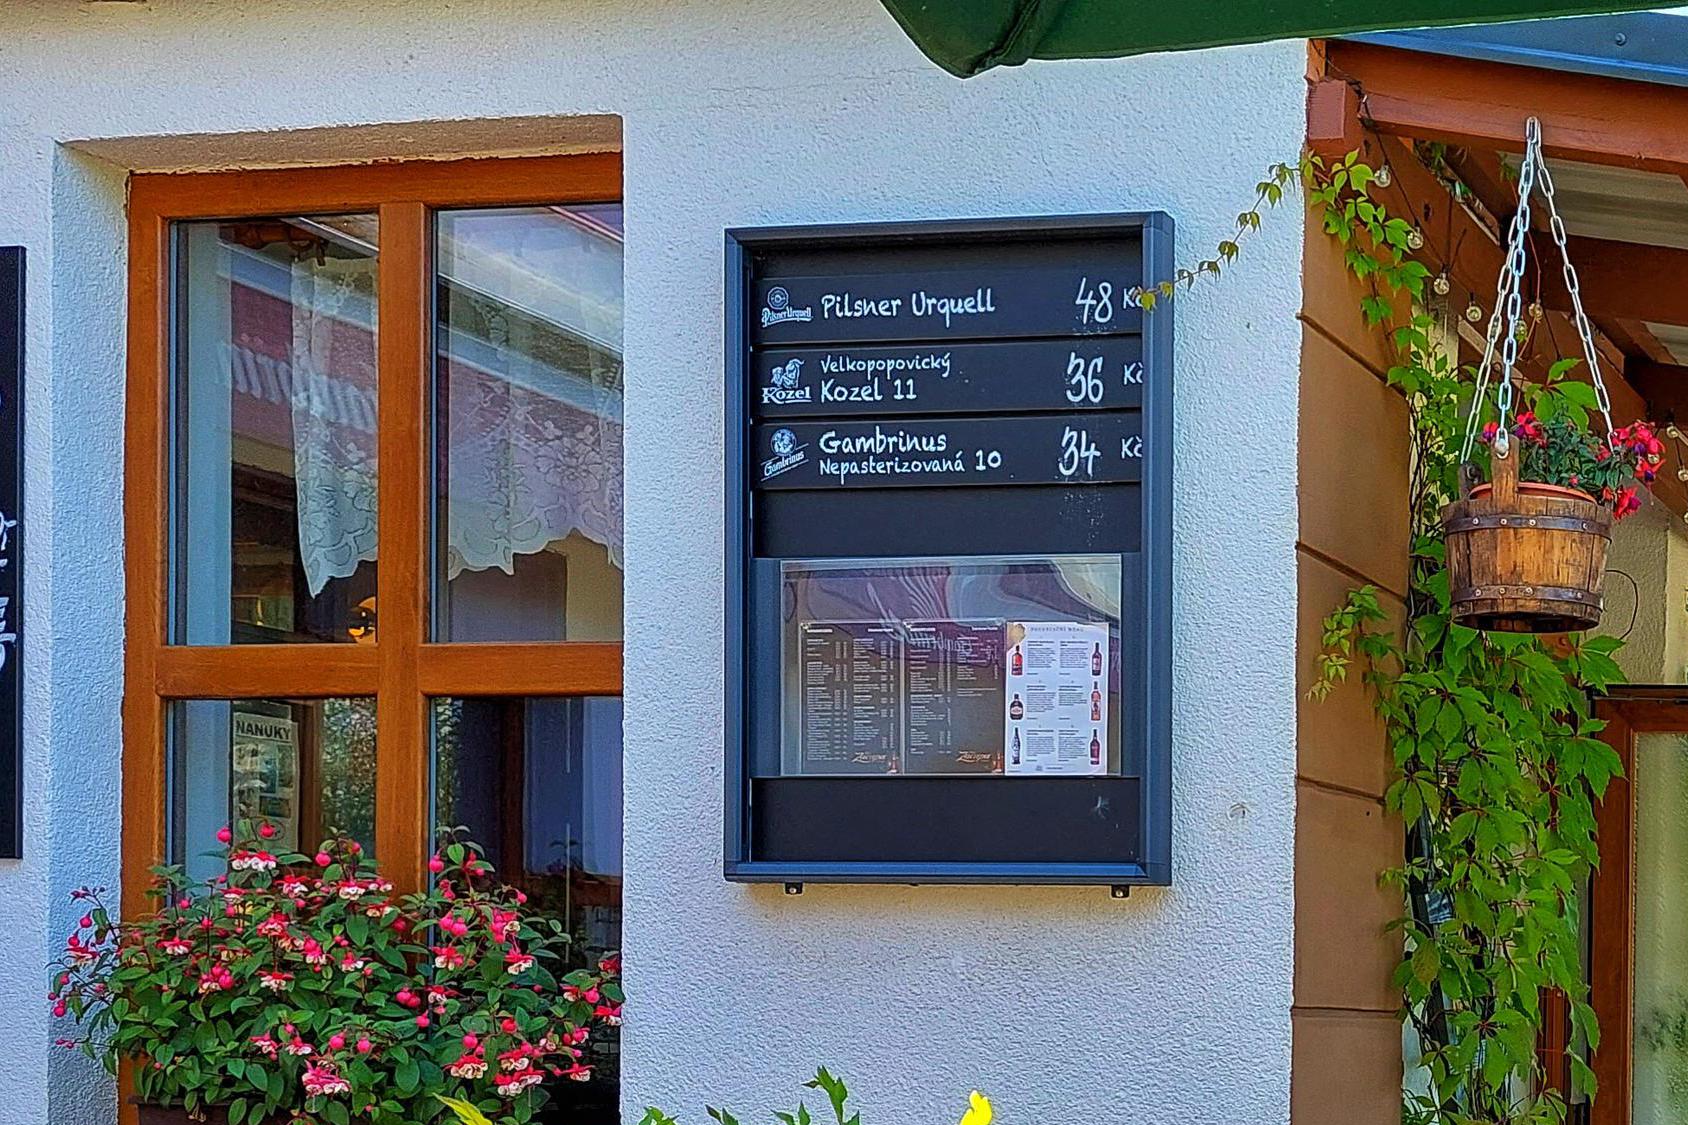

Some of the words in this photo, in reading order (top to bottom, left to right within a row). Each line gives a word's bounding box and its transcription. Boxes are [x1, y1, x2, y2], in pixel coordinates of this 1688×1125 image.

[821, 292, 902, 319] Pilsner
[911, 288, 996, 329] Urquell
[1075, 276, 1114, 325] 48
[820, 352, 951, 380] Velkopopovický
[821, 377, 883, 403] Kozel
[893, 378, 917, 400] 11
[1065, 351, 1104, 403] 36
[762, 386, 812, 404] Kozel
[764, 450, 805, 477] Gambrinus
[819, 425, 947, 454] Gambrinus
[1058, 426, 1101, 477] 34
[819, 450, 965, 485] Nepasterizovaná
[975, 449, 1002, 471] 10
[234, 720, 291, 740] NANUKY
